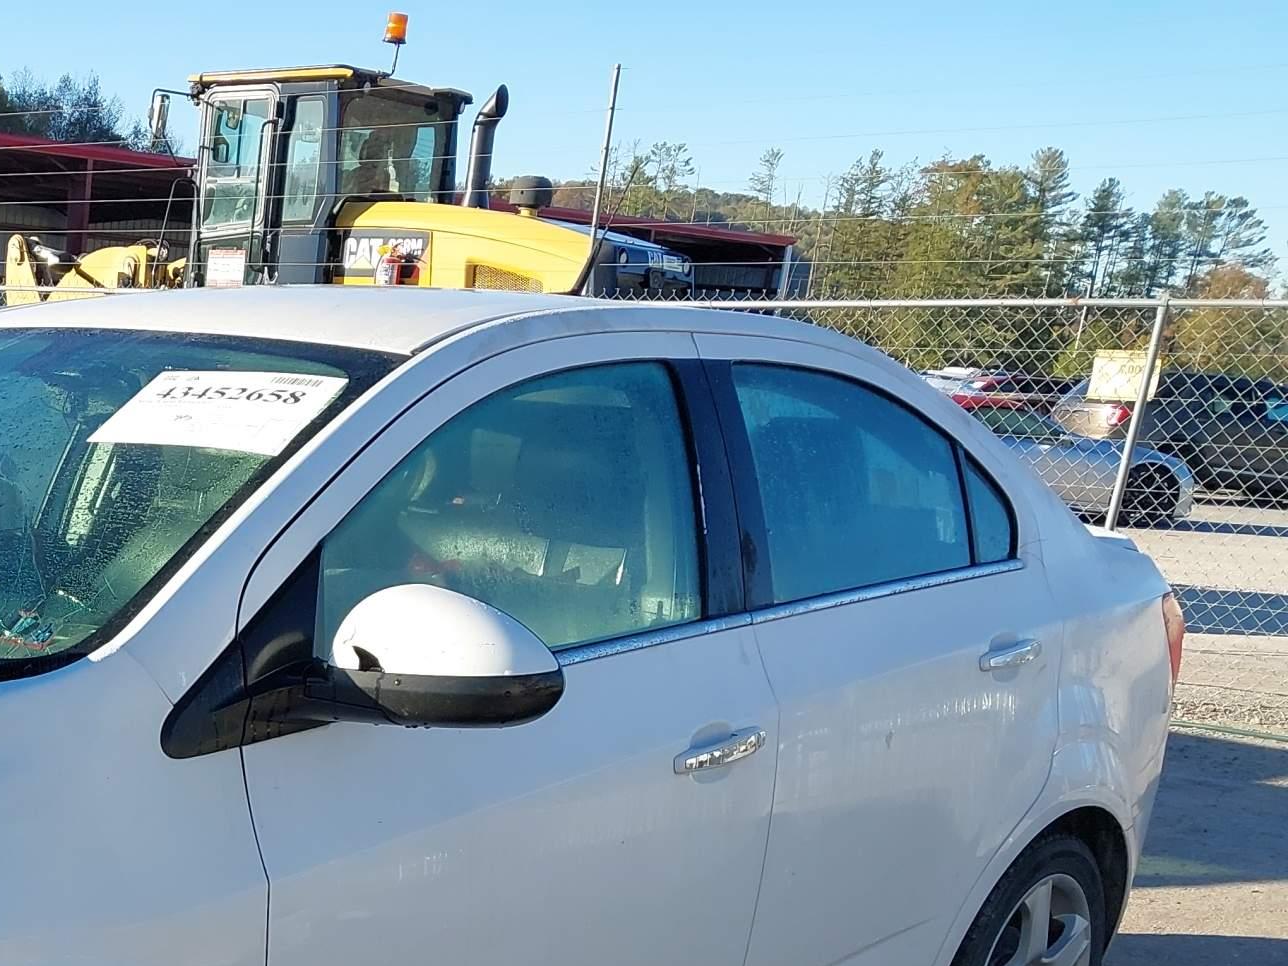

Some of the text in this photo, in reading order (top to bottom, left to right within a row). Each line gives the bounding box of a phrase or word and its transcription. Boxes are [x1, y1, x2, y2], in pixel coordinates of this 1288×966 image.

[343, 237, 384, 269] CAT
[647, 250, 663, 268] CAT
[156, 385, 307, 405] 43452658
